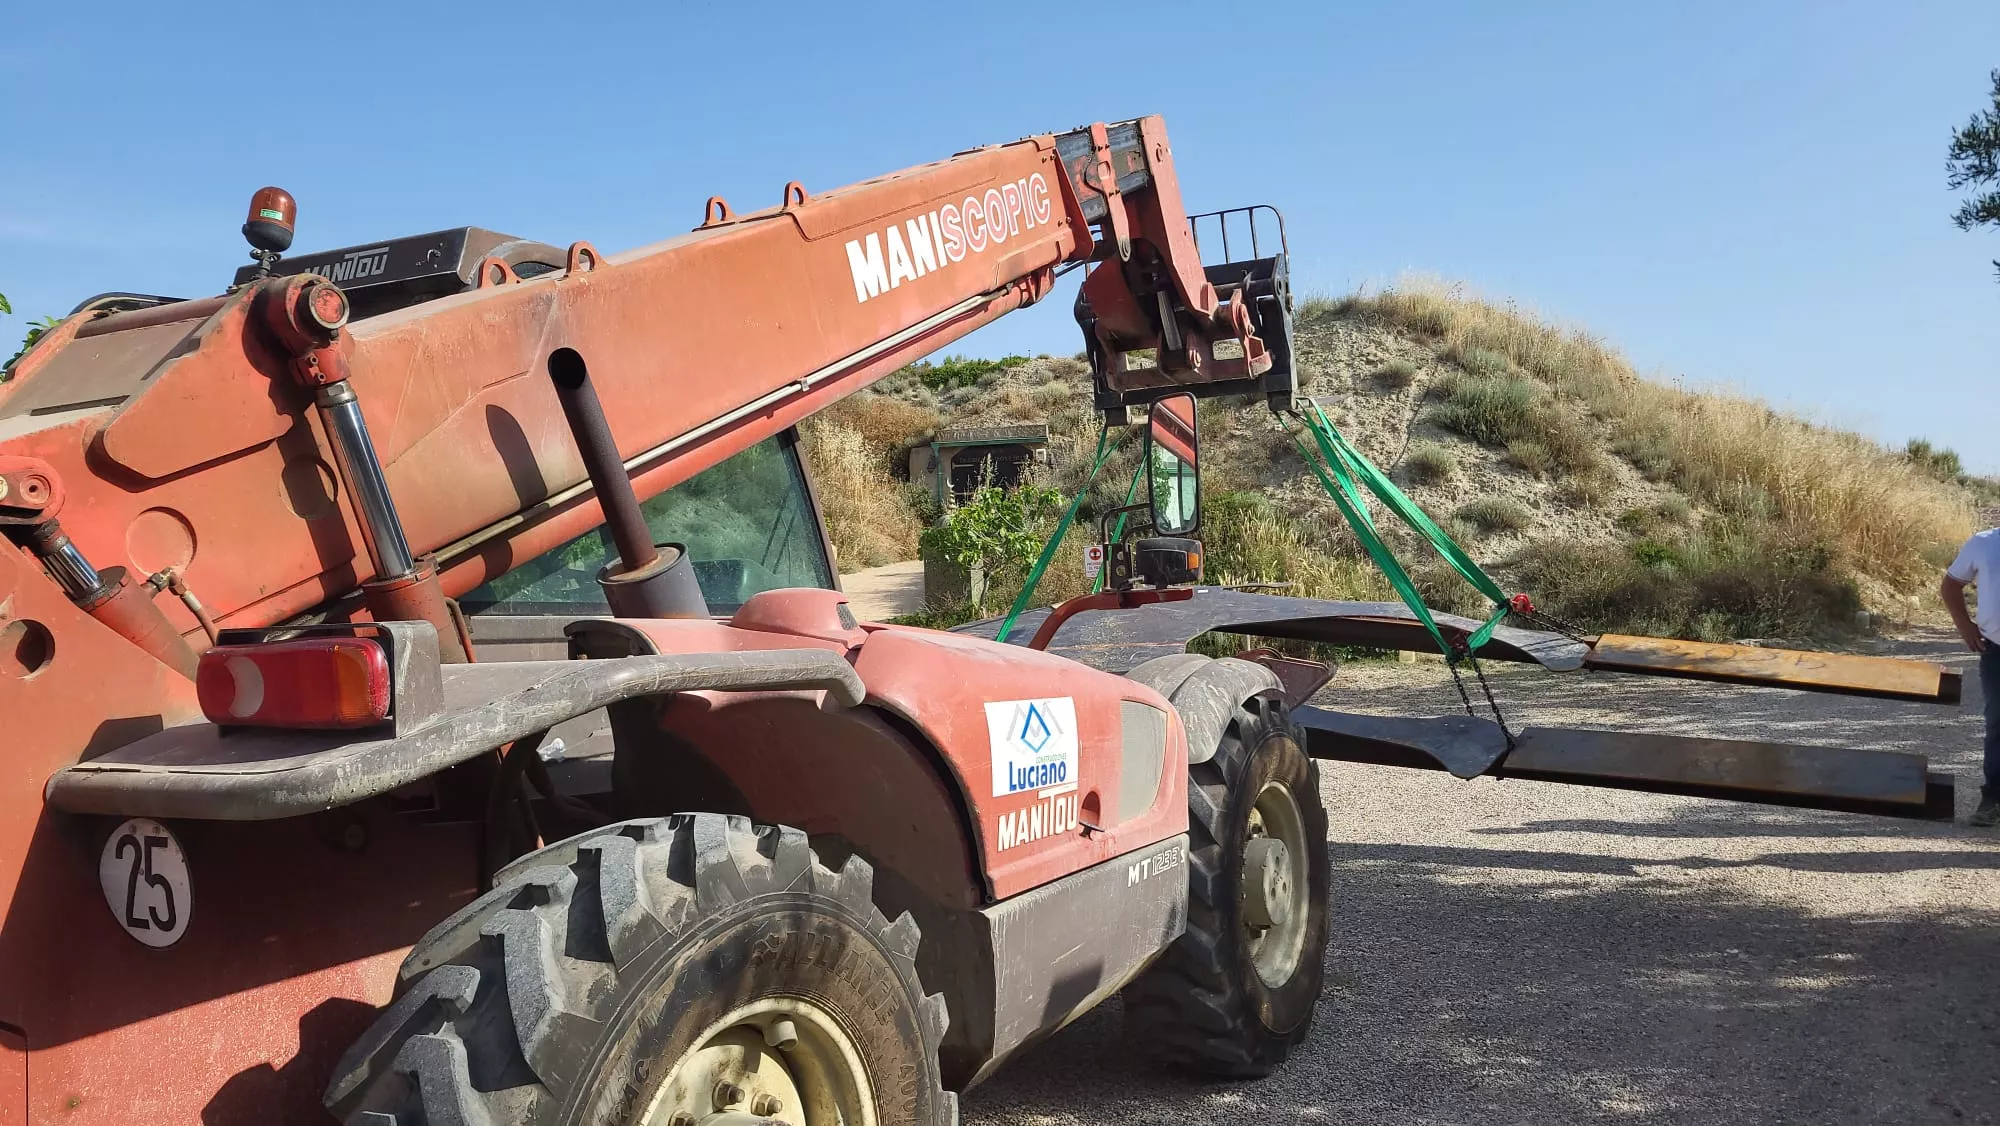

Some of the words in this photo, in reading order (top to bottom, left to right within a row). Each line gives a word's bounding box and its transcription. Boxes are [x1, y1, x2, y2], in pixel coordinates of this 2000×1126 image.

[845, 172, 1051, 304] MANISCOPIC
[1008, 760, 1067, 792] Luciano
[997, 781, 1079, 852] MANITOU
[115, 833, 177, 932] 25
[1127, 857, 1151, 888] MT
